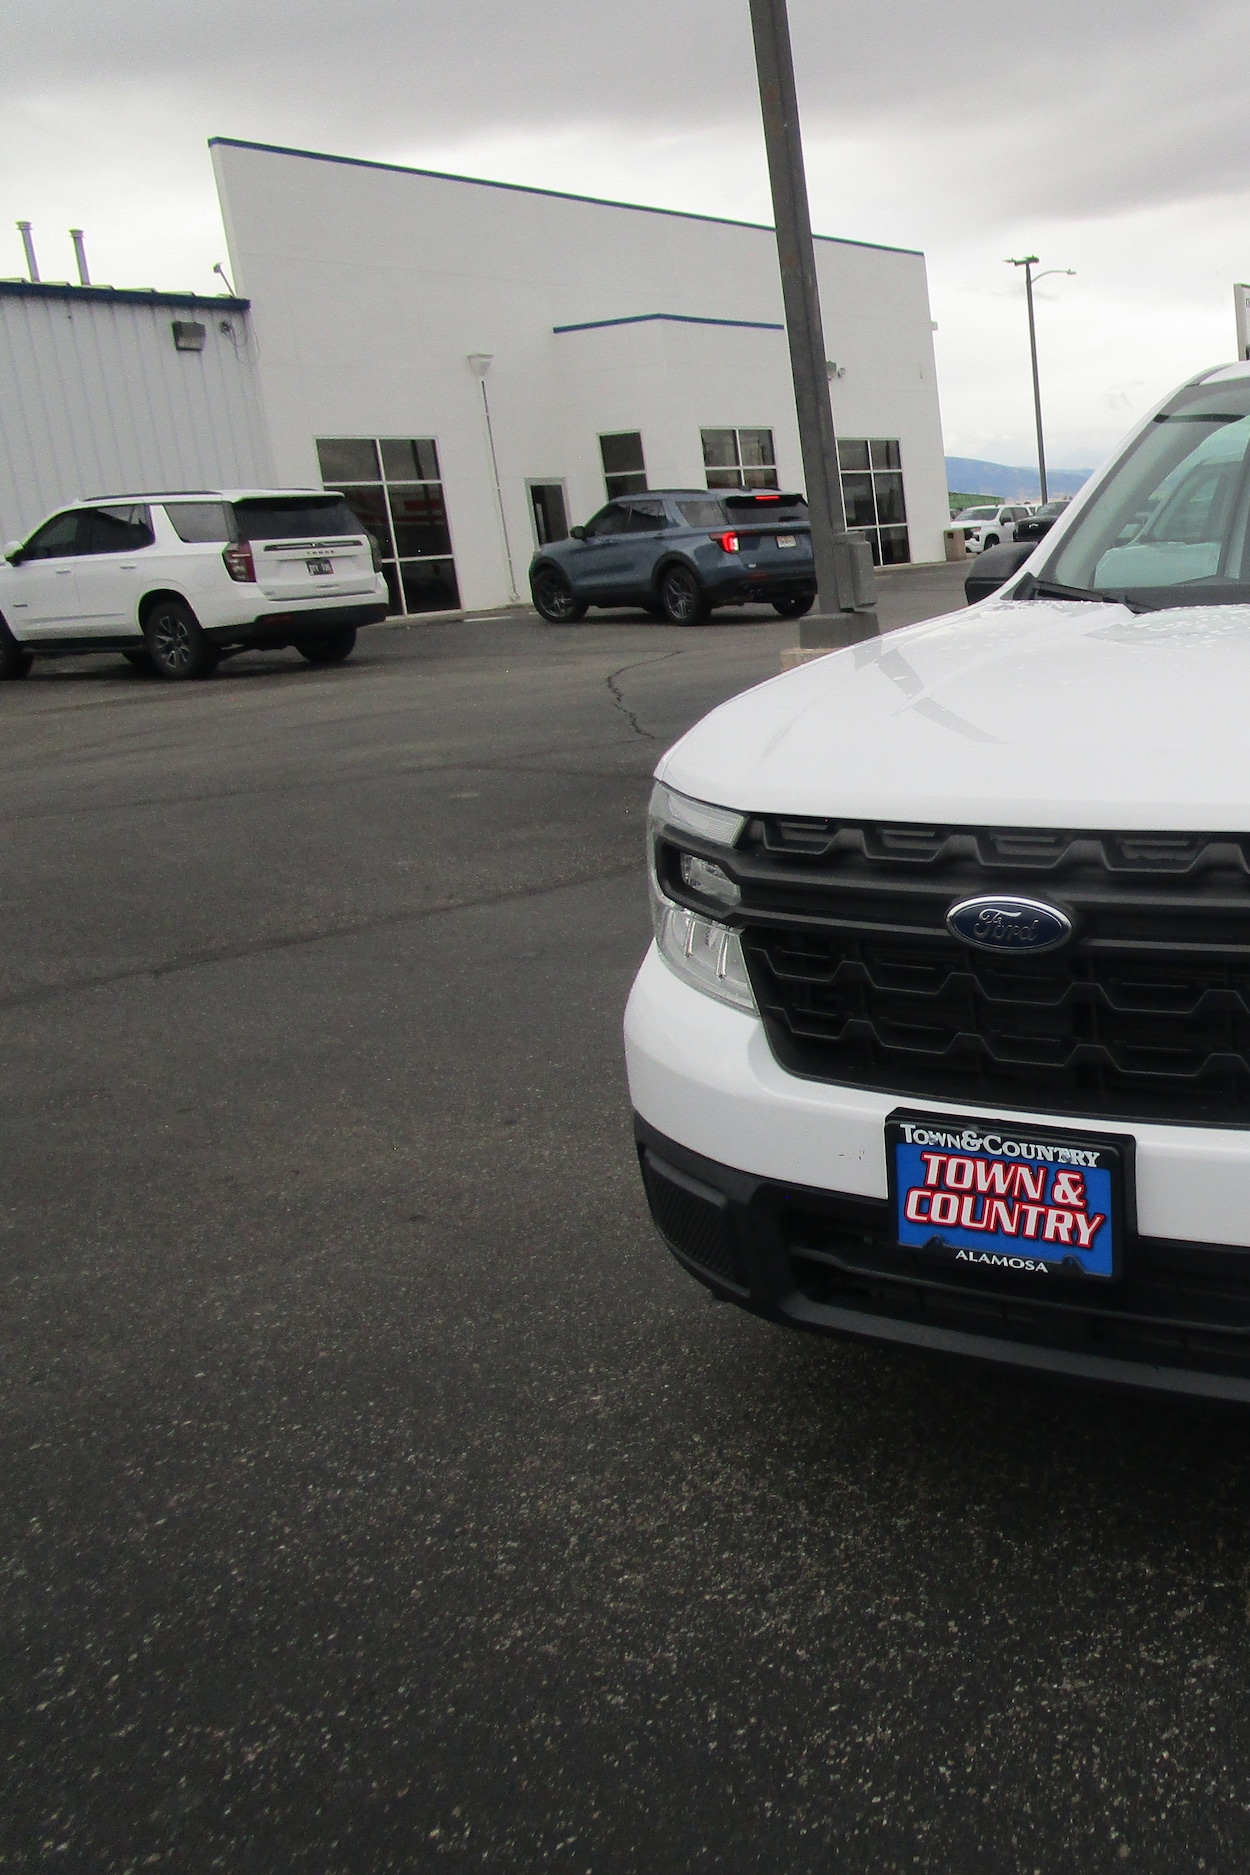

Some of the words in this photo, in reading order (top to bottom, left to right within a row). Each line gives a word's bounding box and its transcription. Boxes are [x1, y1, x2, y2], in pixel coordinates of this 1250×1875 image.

[973, 908, 1039, 941] Ford
[921, 1152, 1047, 1201] TOWN
[1052, 1170, 1085, 1207] &
[905, 1188, 1105, 1248] COUNTRY
[955, 1249, 1049, 1273] ALAMOSA
